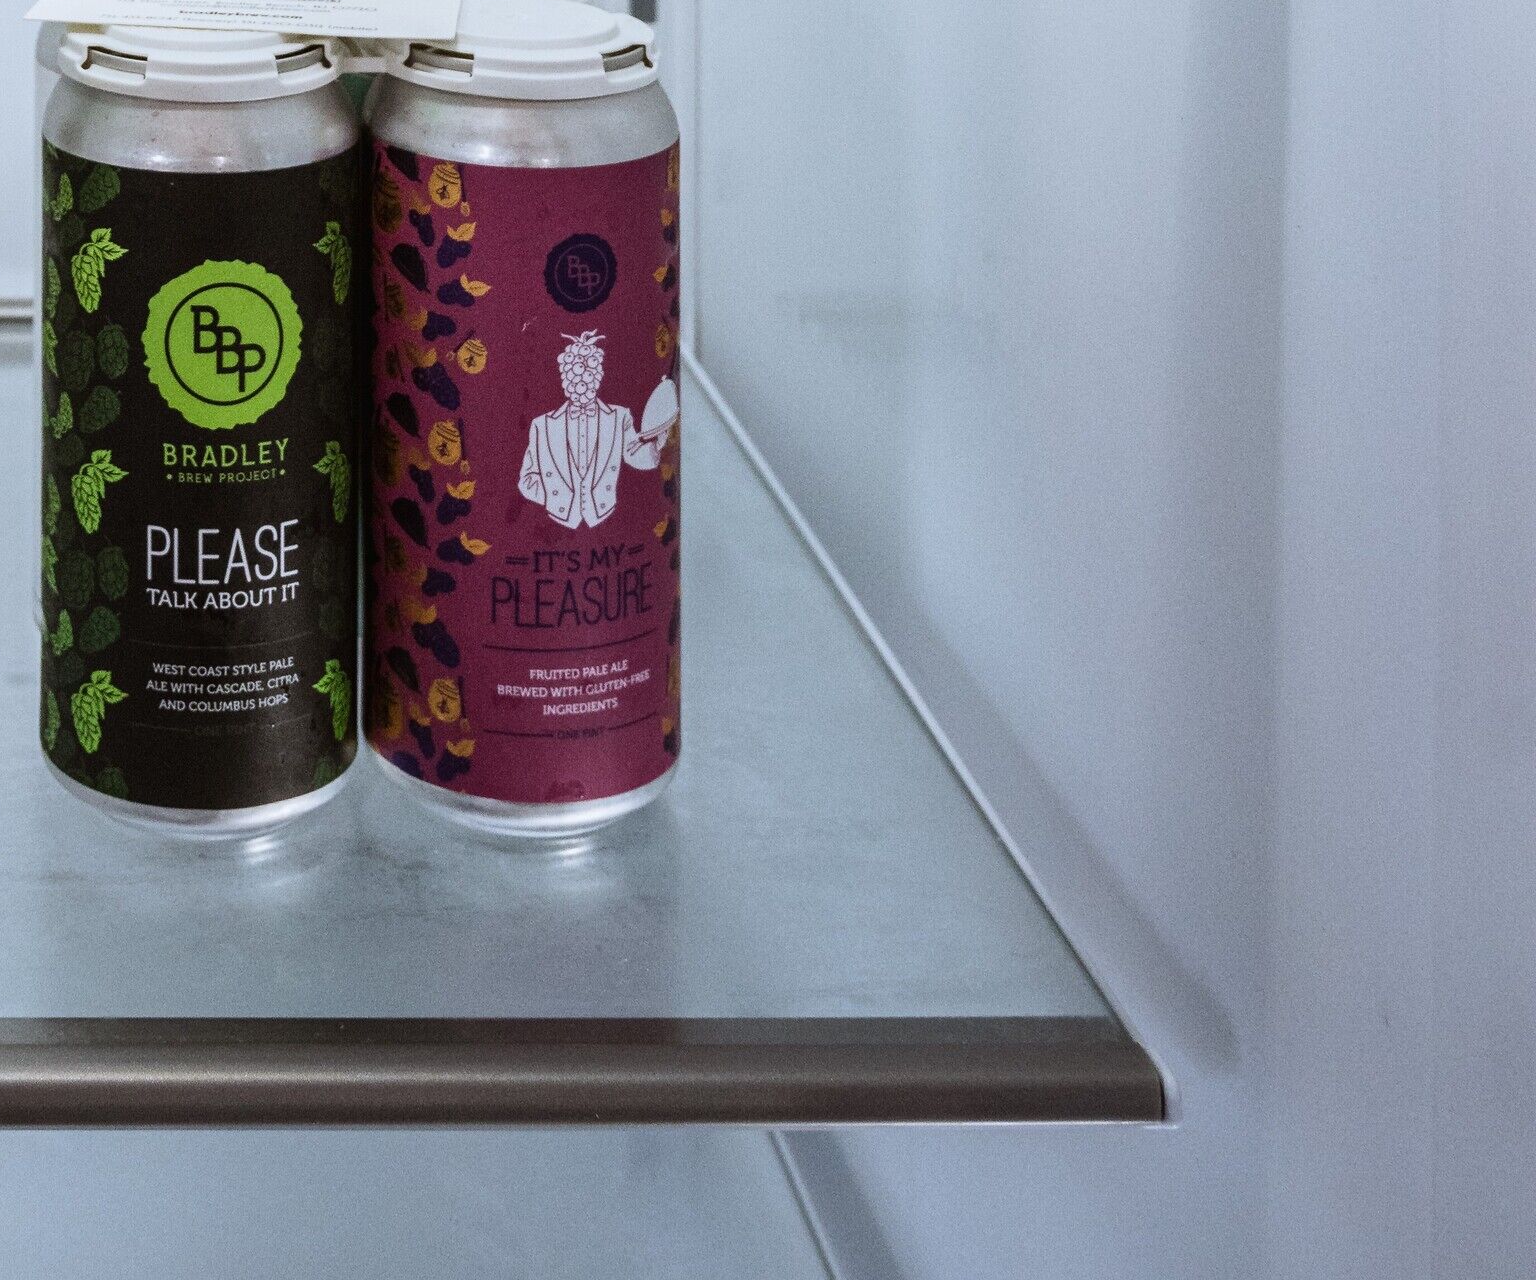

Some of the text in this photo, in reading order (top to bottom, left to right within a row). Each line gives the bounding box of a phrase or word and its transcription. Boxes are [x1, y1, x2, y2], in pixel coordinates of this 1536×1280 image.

[190, 304, 267, 392] BBP
[162, 437, 289, 468] BRADLEY
[178, 468, 276, 484] BREW PROJECT
[146, 518, 299, 585] PLEASE
[588, 543, 626, 571] MY
[146, 582, 300, 610] TALK ABOUT IT
[490, 560, 653, 629] PLEASURE
[152, 656, 294, 677] WEST COAST STYLE PALE
[529, 659, 629, 681] FRUITED PALE ALE
[146, 673, 300, 695] ALE WITH CASCADE, CITRA
[497, 669, 651, 699] BREWED WITH GLUTEN-FREE
[159, 693, 289, 712] AND COLUMBUS HOPS
[543, 698, 619, 716] INGREDIENTS
